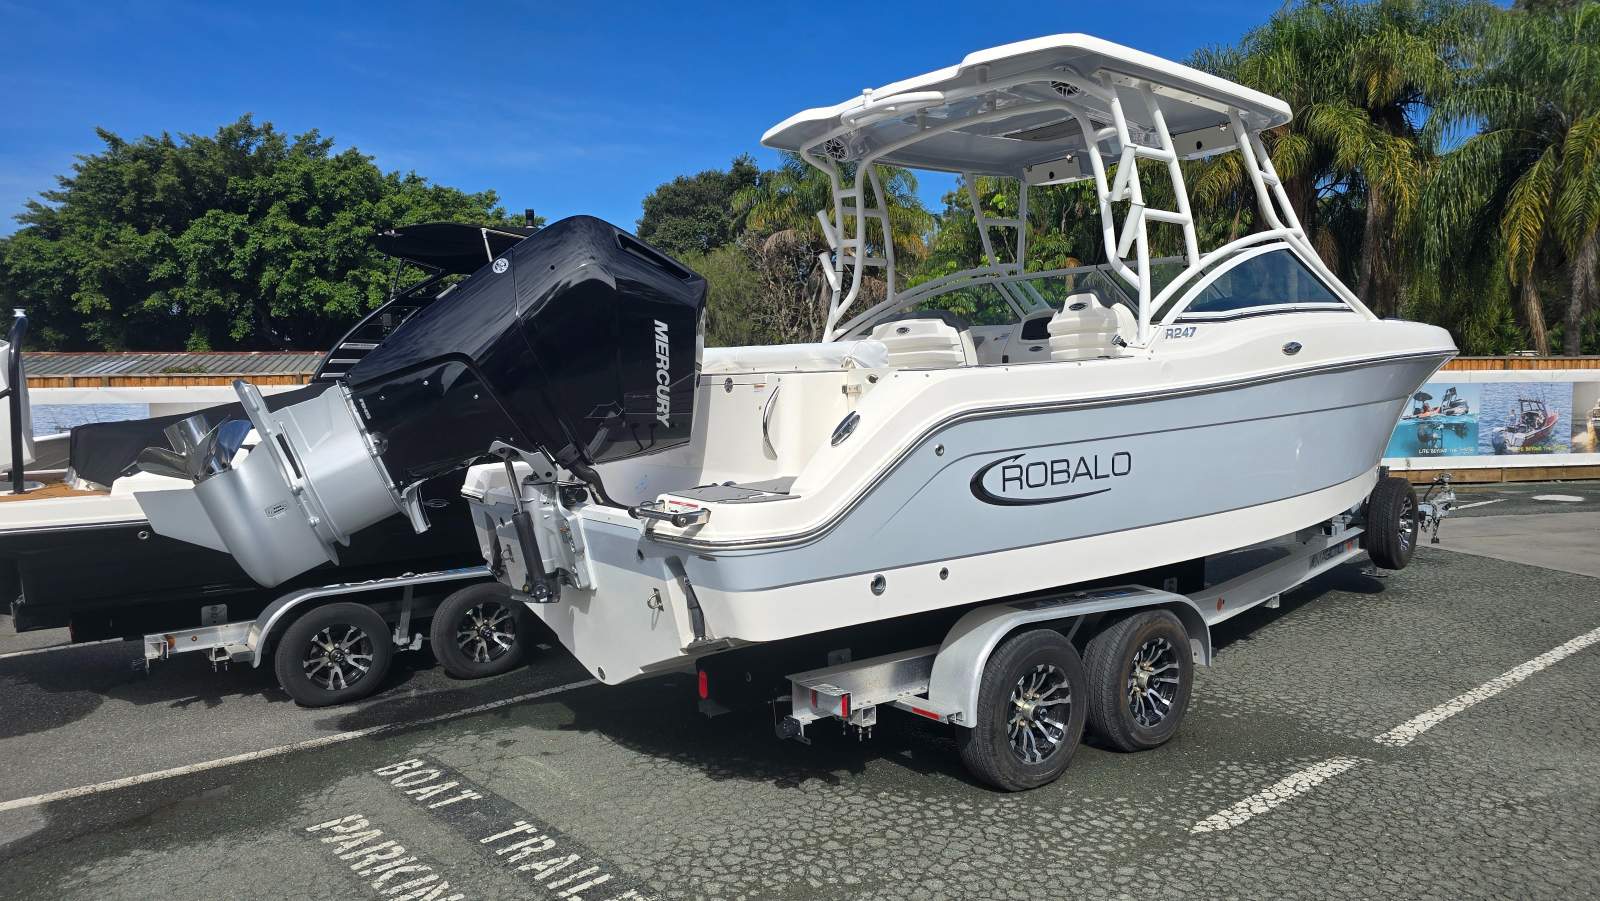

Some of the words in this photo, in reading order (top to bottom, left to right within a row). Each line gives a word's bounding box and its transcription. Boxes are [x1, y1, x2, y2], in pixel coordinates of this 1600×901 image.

[1165, 326, 1197, 340] R247
[654, 319, 670, 428] MERCURY
[1001, 451, 1132, 492] ROBALO
[373, 758, 483, 810] BOAT
